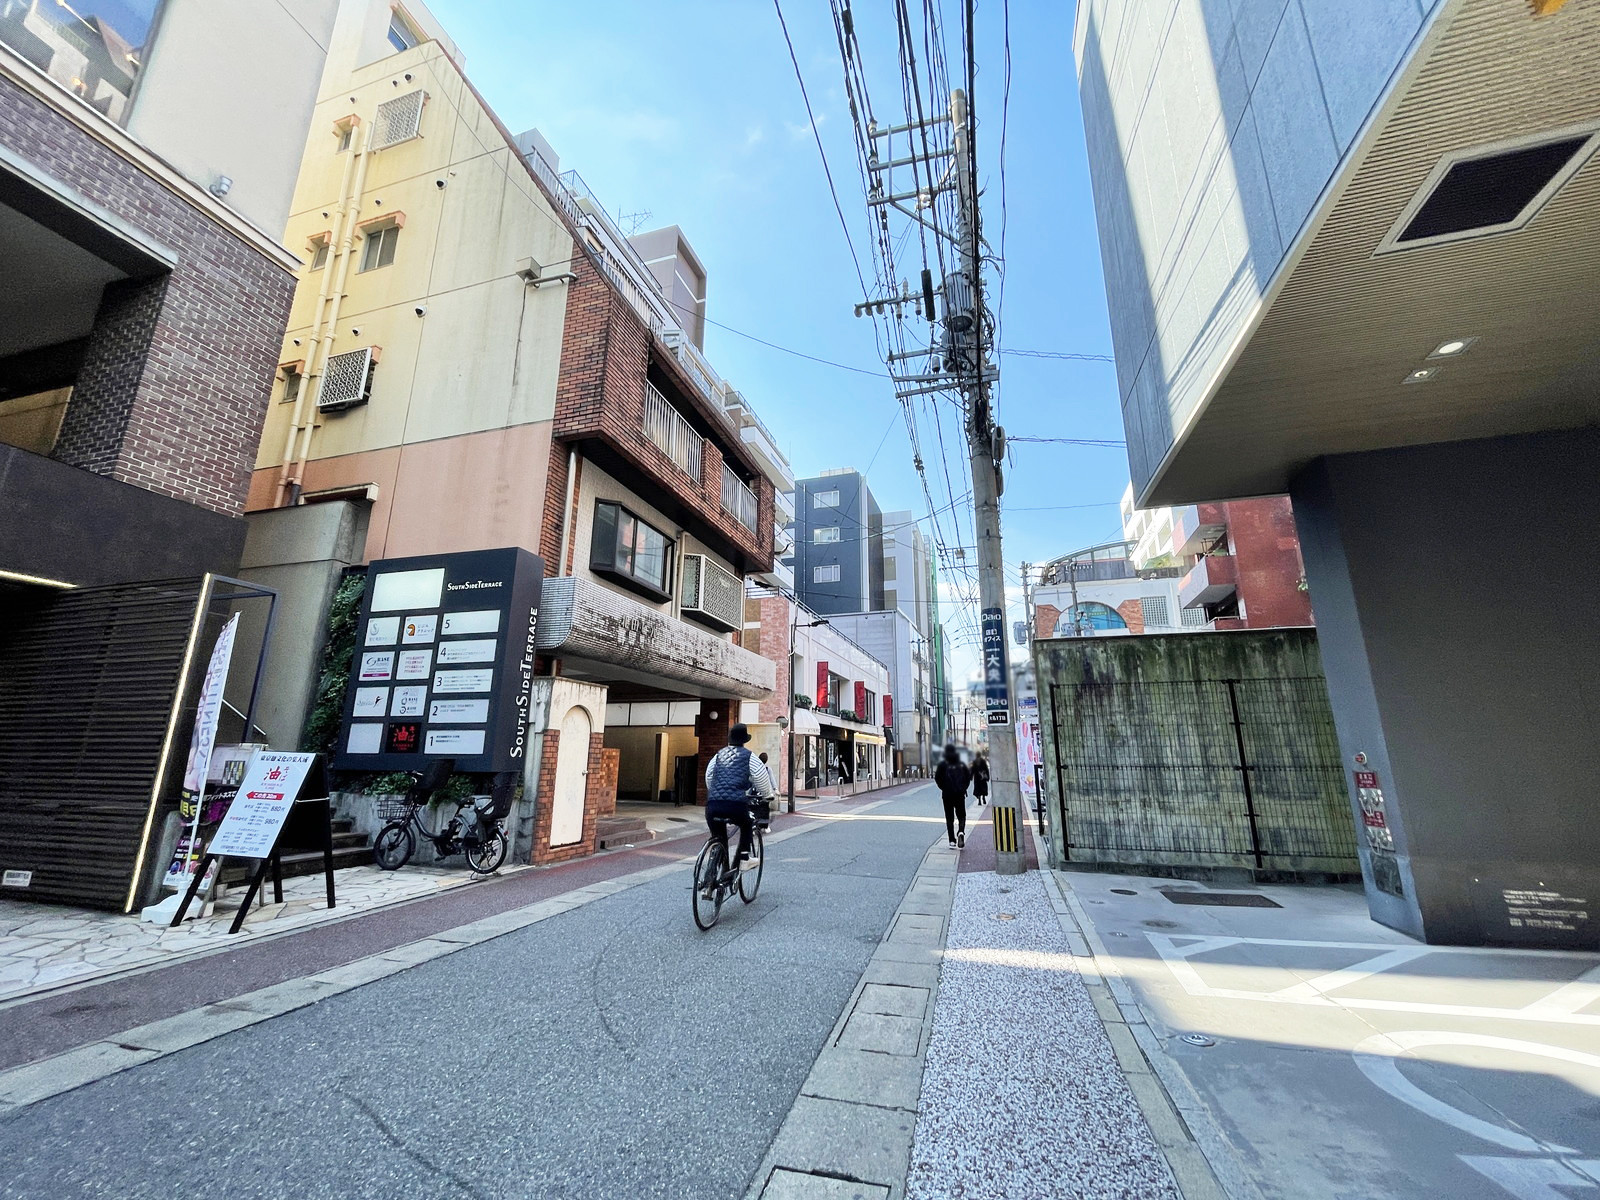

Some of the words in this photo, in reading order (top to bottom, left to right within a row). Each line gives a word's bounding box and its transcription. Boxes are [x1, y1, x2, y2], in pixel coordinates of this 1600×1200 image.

[444, 619, 451, 629] 5
[440, 647, 447, 657] 4
[436, 676, 443, 687] 3
[432, 705, 439, 716] 2
[429, 735, 434, 747] 1
